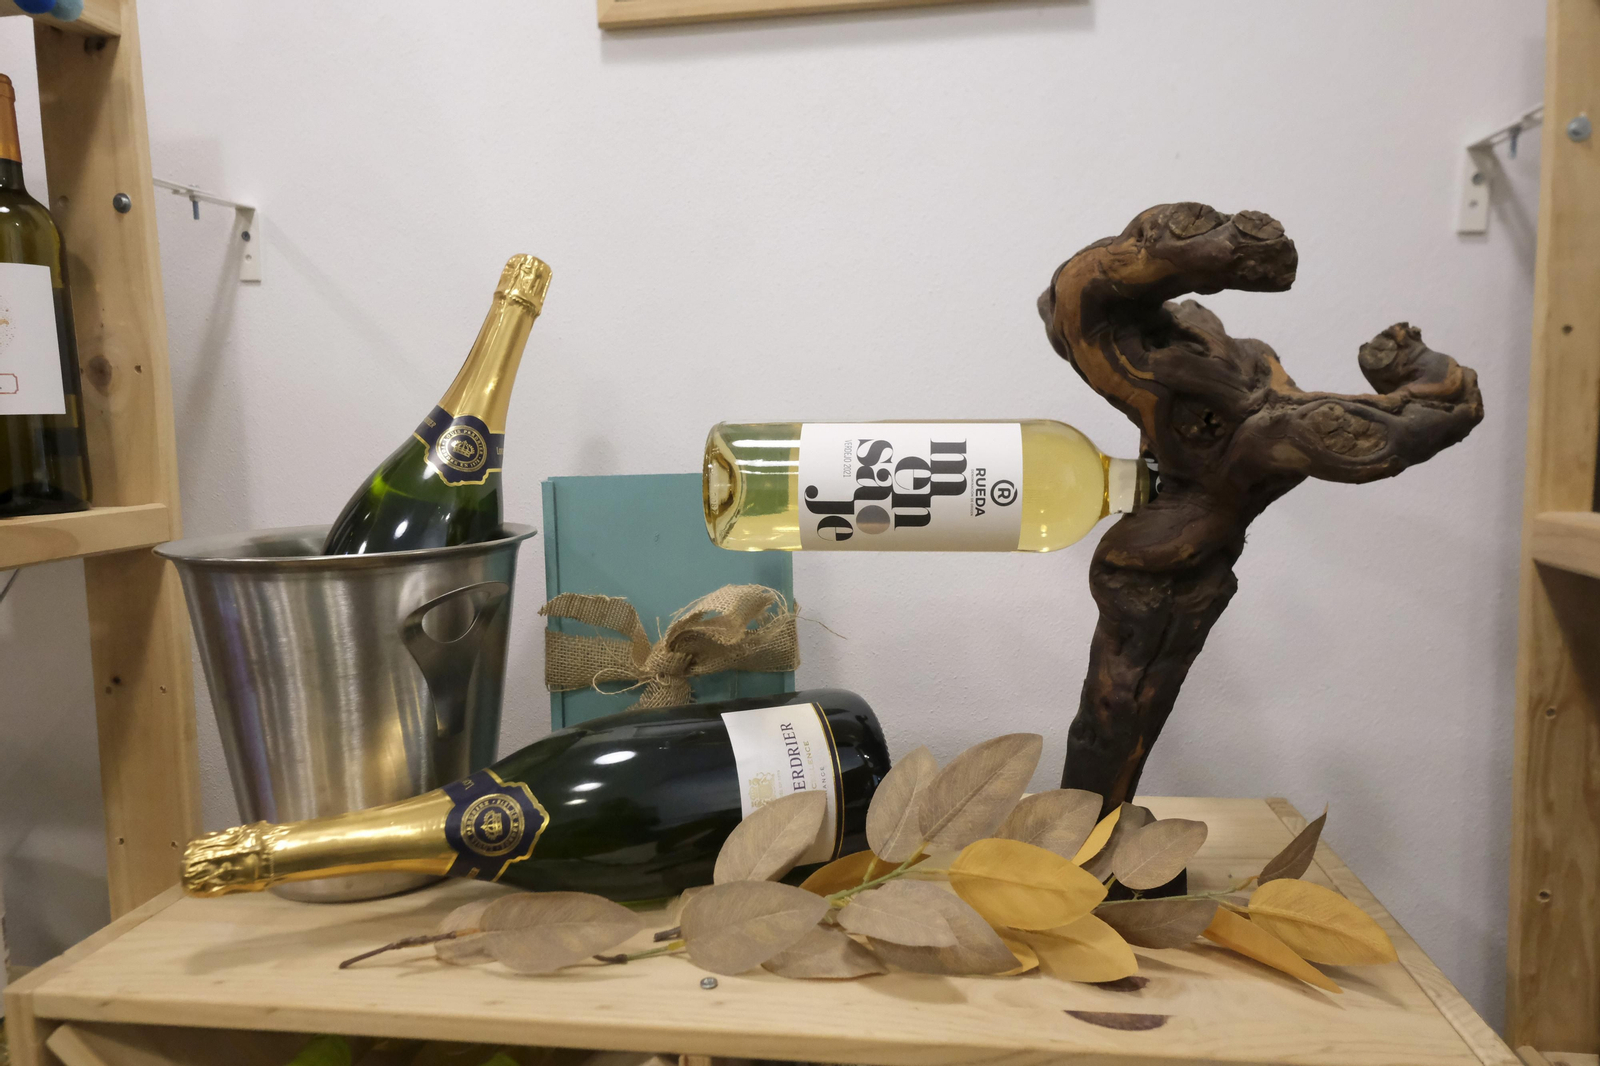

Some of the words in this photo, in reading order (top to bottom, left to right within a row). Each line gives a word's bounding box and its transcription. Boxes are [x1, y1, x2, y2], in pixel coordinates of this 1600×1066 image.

[844, 440, 852, 463] VERDEJO
[843, 464, 851, 478] 2021
[975, 468, 986, 517] RUEDA
[780, 722, 806, 791] ERDRIER
